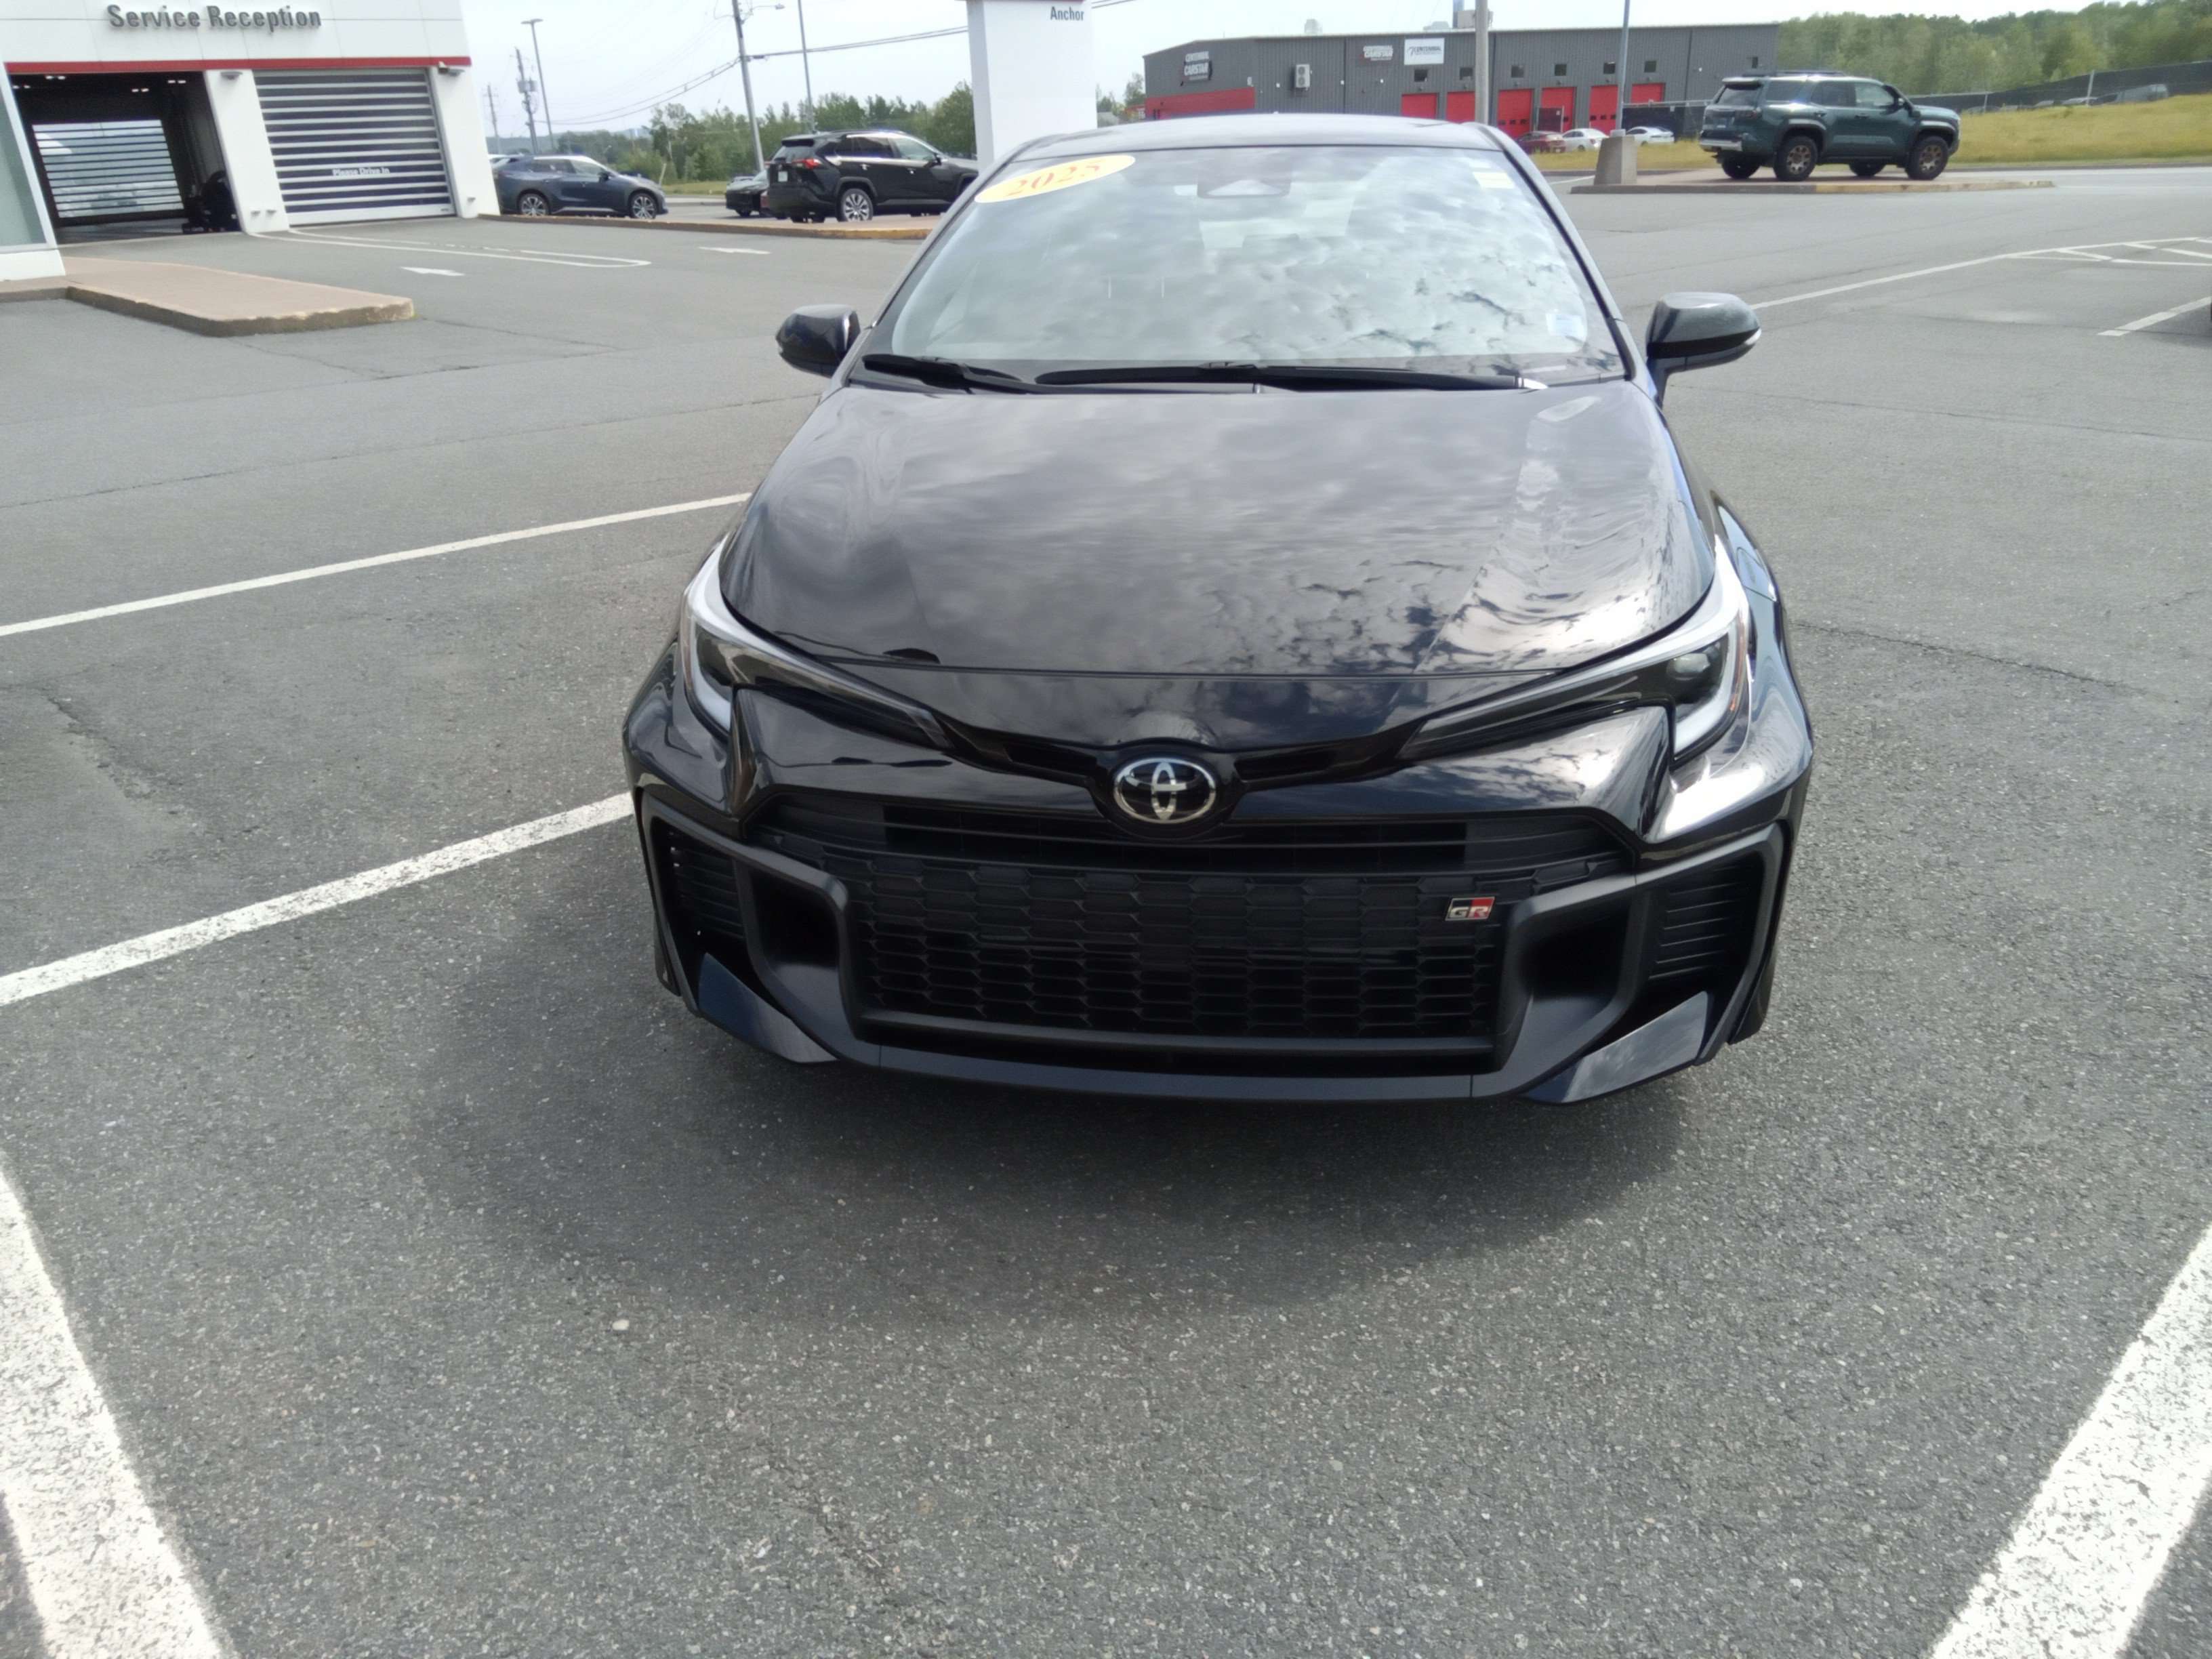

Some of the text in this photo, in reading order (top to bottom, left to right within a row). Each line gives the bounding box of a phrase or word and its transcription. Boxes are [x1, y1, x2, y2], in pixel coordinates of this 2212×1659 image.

[106, 3, 322, 33] Service Reception
[1050, 5, 1085, 21] Anchor
[1004, 159, 1107, 198] 2025
[1449, 905, 1491, 918] GR
